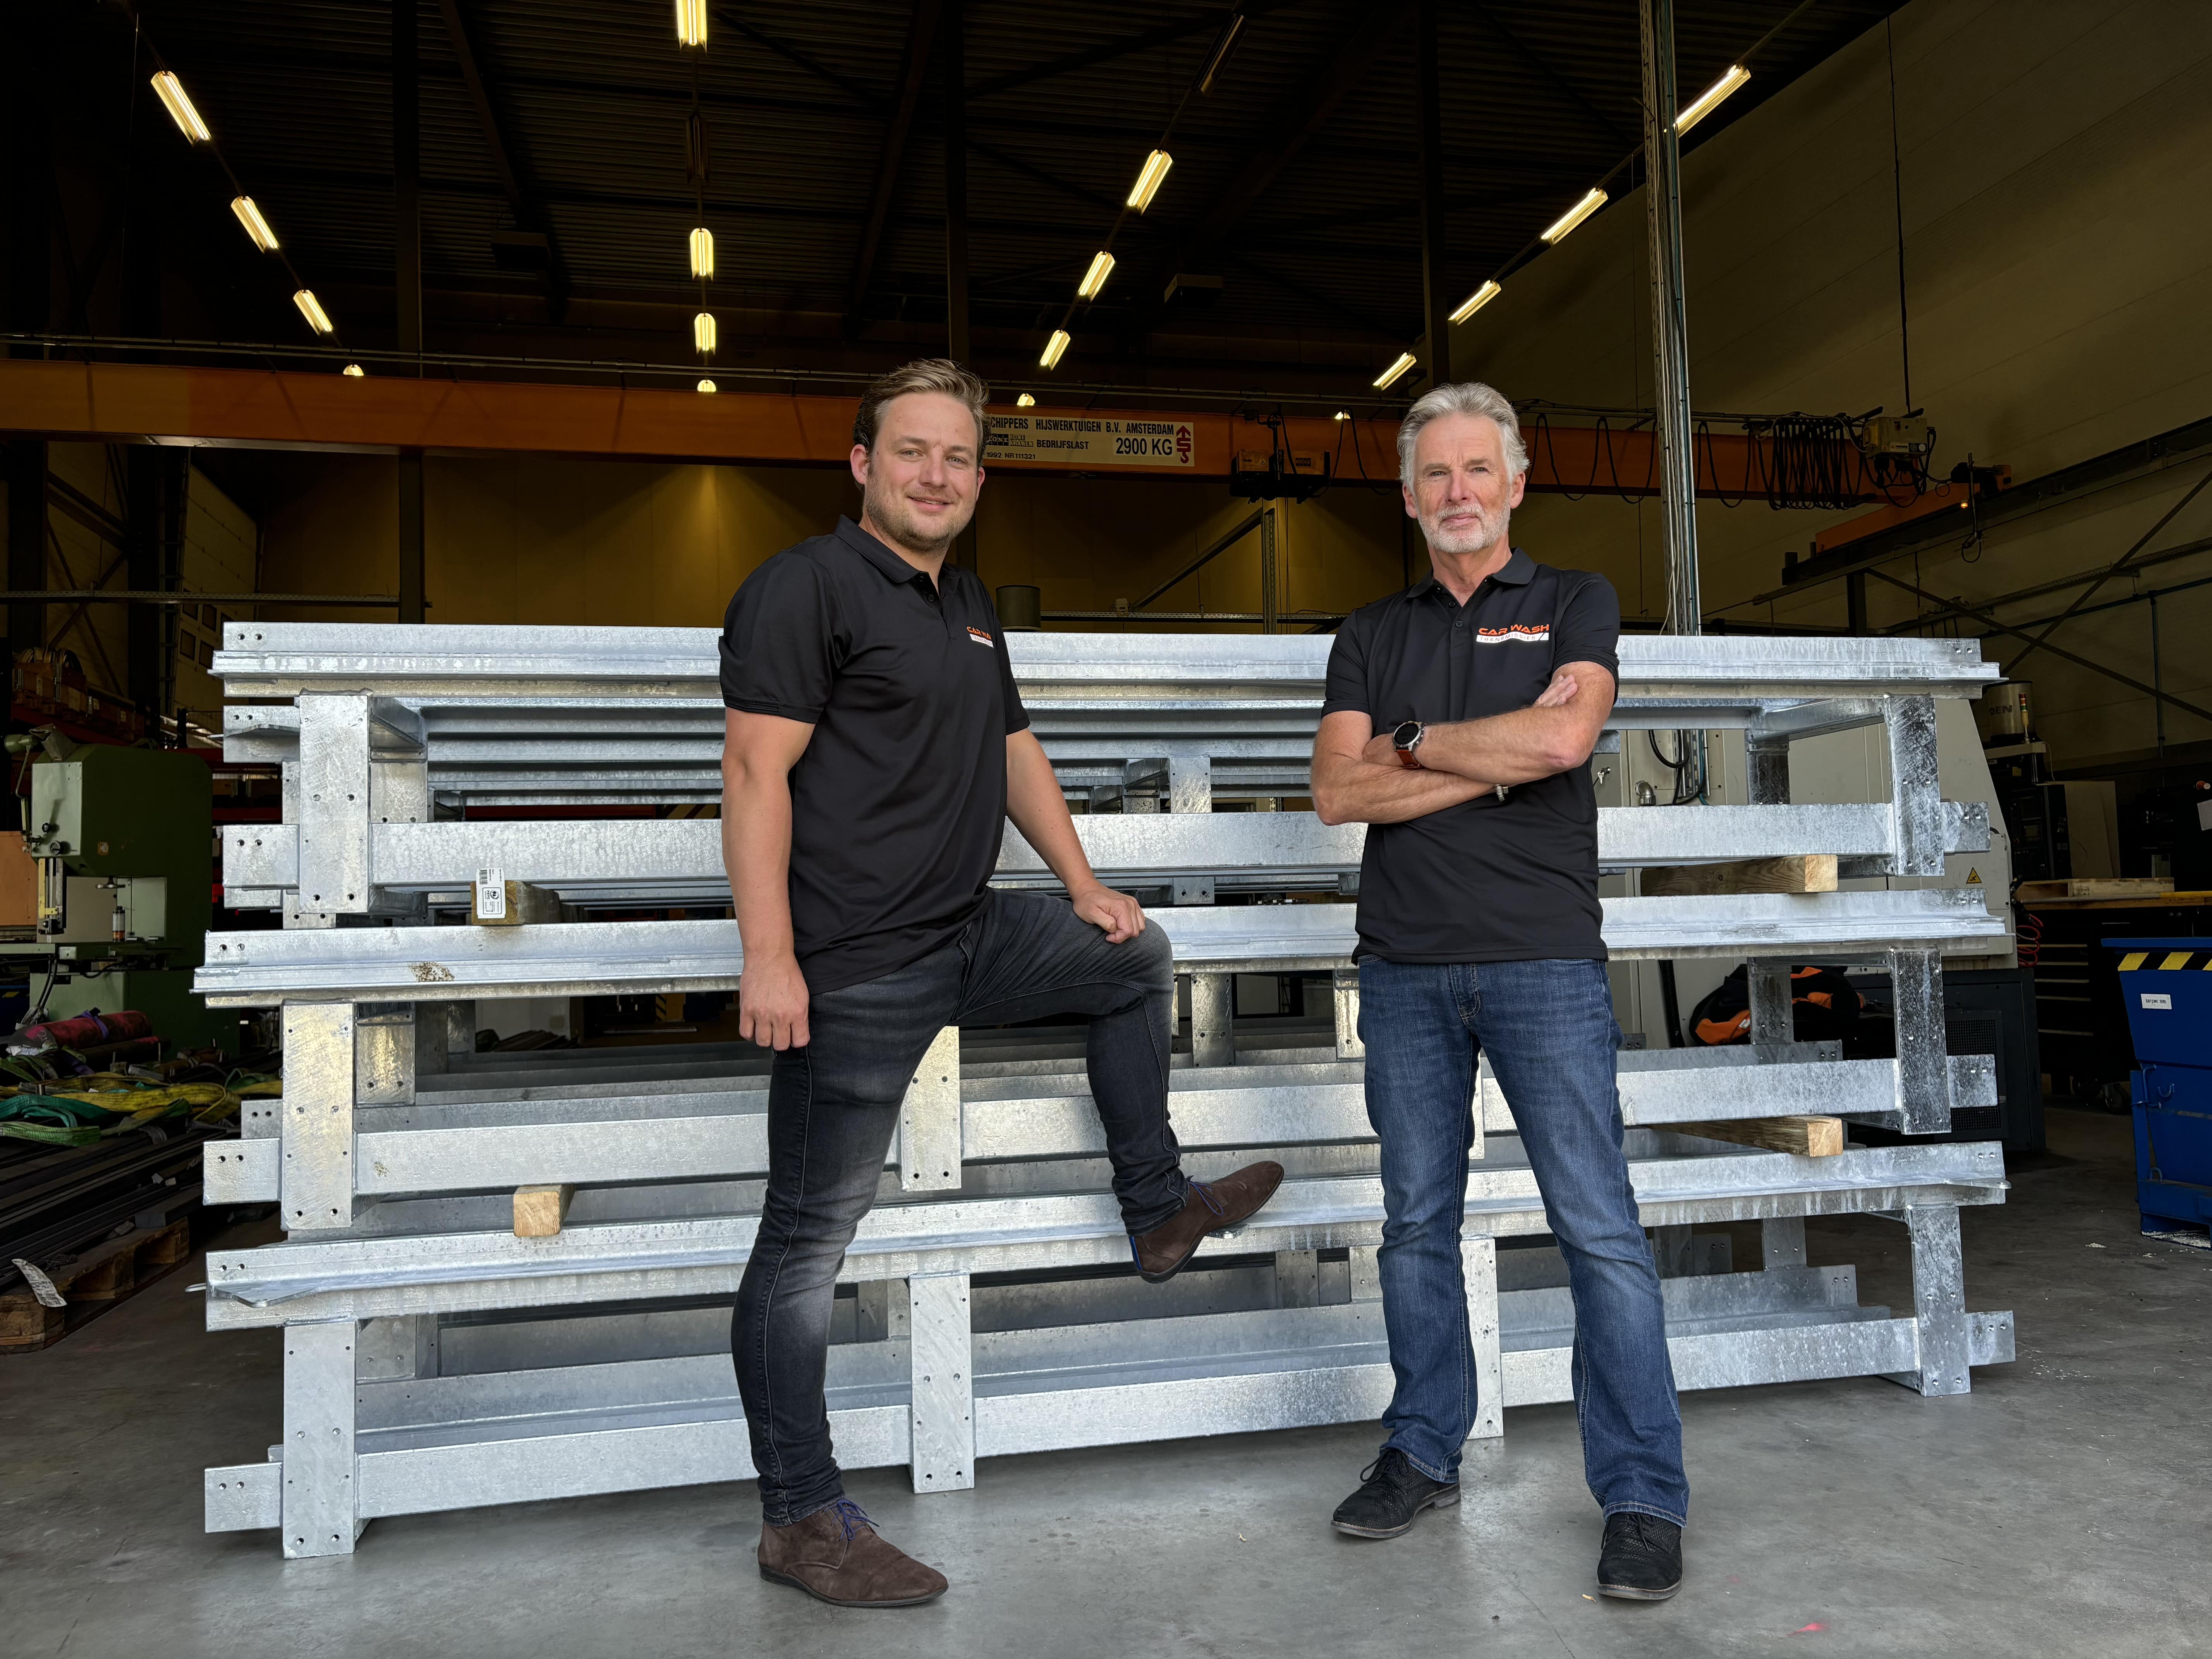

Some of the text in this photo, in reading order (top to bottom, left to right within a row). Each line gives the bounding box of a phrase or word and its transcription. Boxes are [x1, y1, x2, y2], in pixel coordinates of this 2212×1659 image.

[986, 417, 1174, 435] CHIPPERS HIJSWERKTUIGEN B.V. AMSTERDAM
[1037, 440, 1089, 449] BEDRIJFSLAST
[1116, 437, 1172, 455] 2900 KG
[967, 627, 982, 636] CAR
[1511, 624, 1549, 633] WASH
